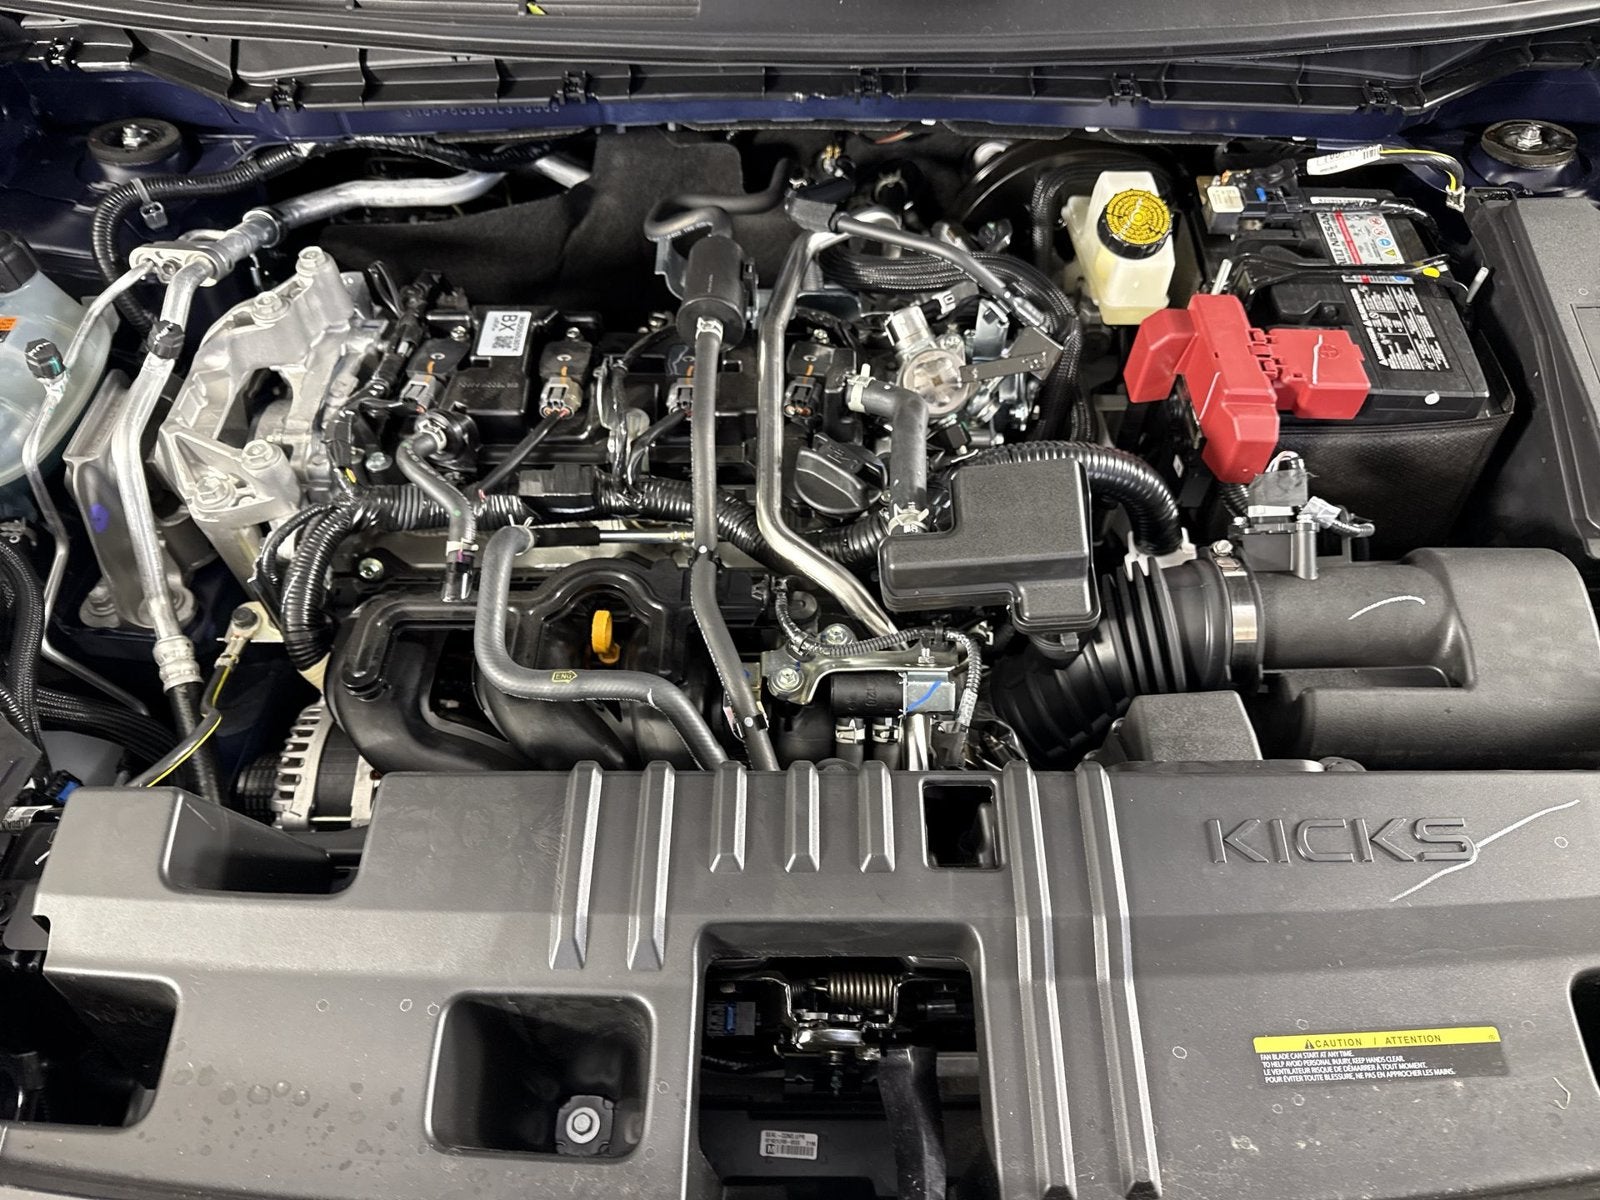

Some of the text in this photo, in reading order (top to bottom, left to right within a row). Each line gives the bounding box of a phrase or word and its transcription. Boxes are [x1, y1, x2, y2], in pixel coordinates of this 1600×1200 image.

[1319, 212, 1342, 247] NISSAN
[499, 314, 518, 332] BX
[1204, 818, 1479, 864] KICKS
[1314, 1037, 1362, 1048] CAUTION
[1384, 1034, 1442, 1045] ATTENTION
[1270, 1060, 1284, 1068] HELP
[1285, 1059, 1302, 1067] AVOID
[1303, 1058, 1331, 1066] PERSONAL
[1351, 1056, 1365, 1064] KEEP
[1365, 1055, 1385, 1063] HANDS
[1271, 1052, 1289, 1060] BLADE
[1264, 1075, 1282, 1083] POUR
[1303, 1073, 1323, 1081] TOUTE
[1365, 1070, 1376, 1078] PAS
[1386, 1068, 1422, 1077] APPROCHER
[1423, 1067, 1433, 1075] LES
[1271, 1066, 1310, 1075] VENTILATEUR
[1311, 1065, 1333, 1073] RISQUE
